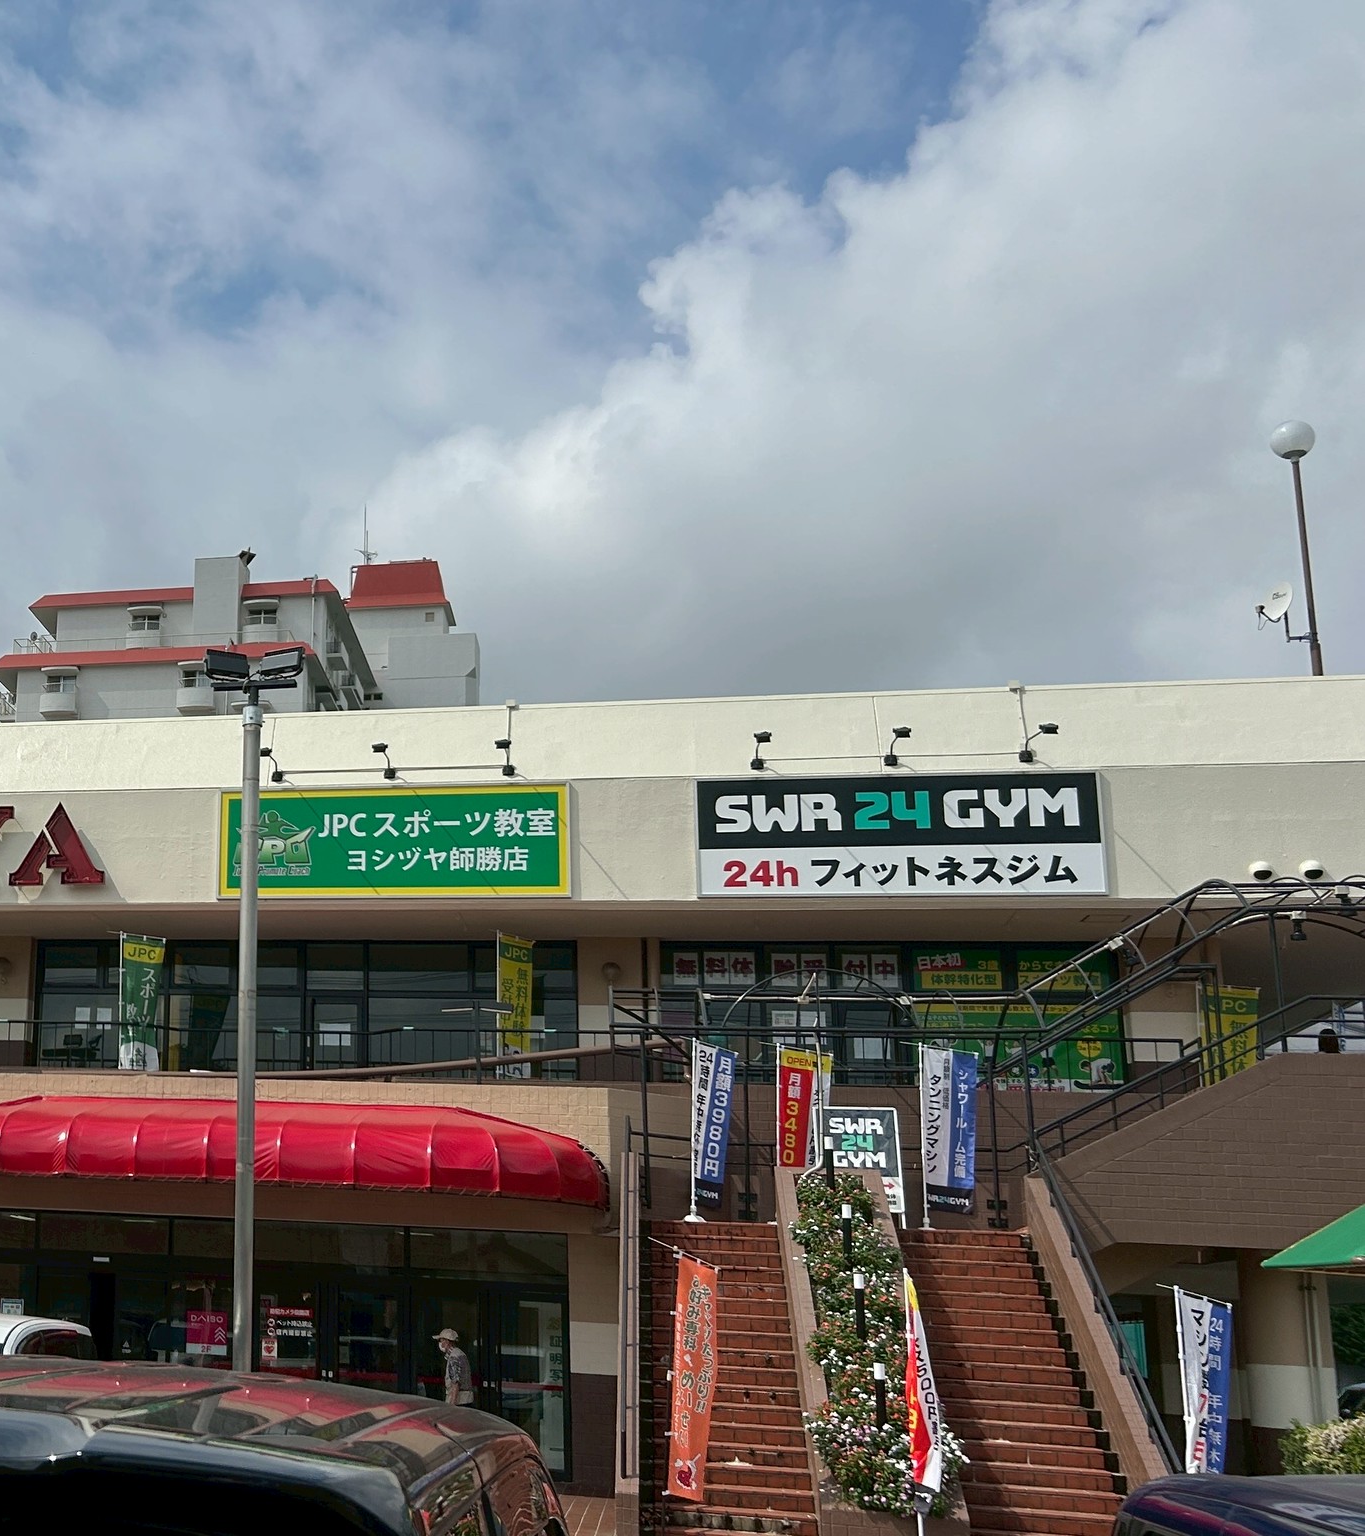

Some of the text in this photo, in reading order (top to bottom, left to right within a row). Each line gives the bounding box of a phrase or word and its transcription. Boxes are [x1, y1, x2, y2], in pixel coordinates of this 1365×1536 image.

[714, 787, 1080, 834] SWR 24 GYM
[318, 808, 556, 839] JPC スポーツ教室
[347, 846, 529, 873] ヨシヅヤ師勝店
[723, 855, 1078, 888] 24h フィットネスジム
[128, 947, 157, 960] JPC
[505, 947, 529, 960] JPC
[917, 953, 962, 970] 日本初
[930, 973, 1101, 986] 体幹特化型 スツ教室
[786, 1056, 812, 1068] OPEN
[704, 1056, 732, 1177] 月額3980円
[784, 1072, 801, 1164] 月額3480
[925, 1074, 942, 1174] タンニングマシン
[953, 1070, 969, 1179] シャワールーム完備
[828, 1117, 884, 1134] SWR
[841, 1134, 874, 1150] 24
[833, 1151, 887, 1168] GYM
[190, 1314, 224, 1324] DAISO
[200, 1345, 212, 1353] 2F
